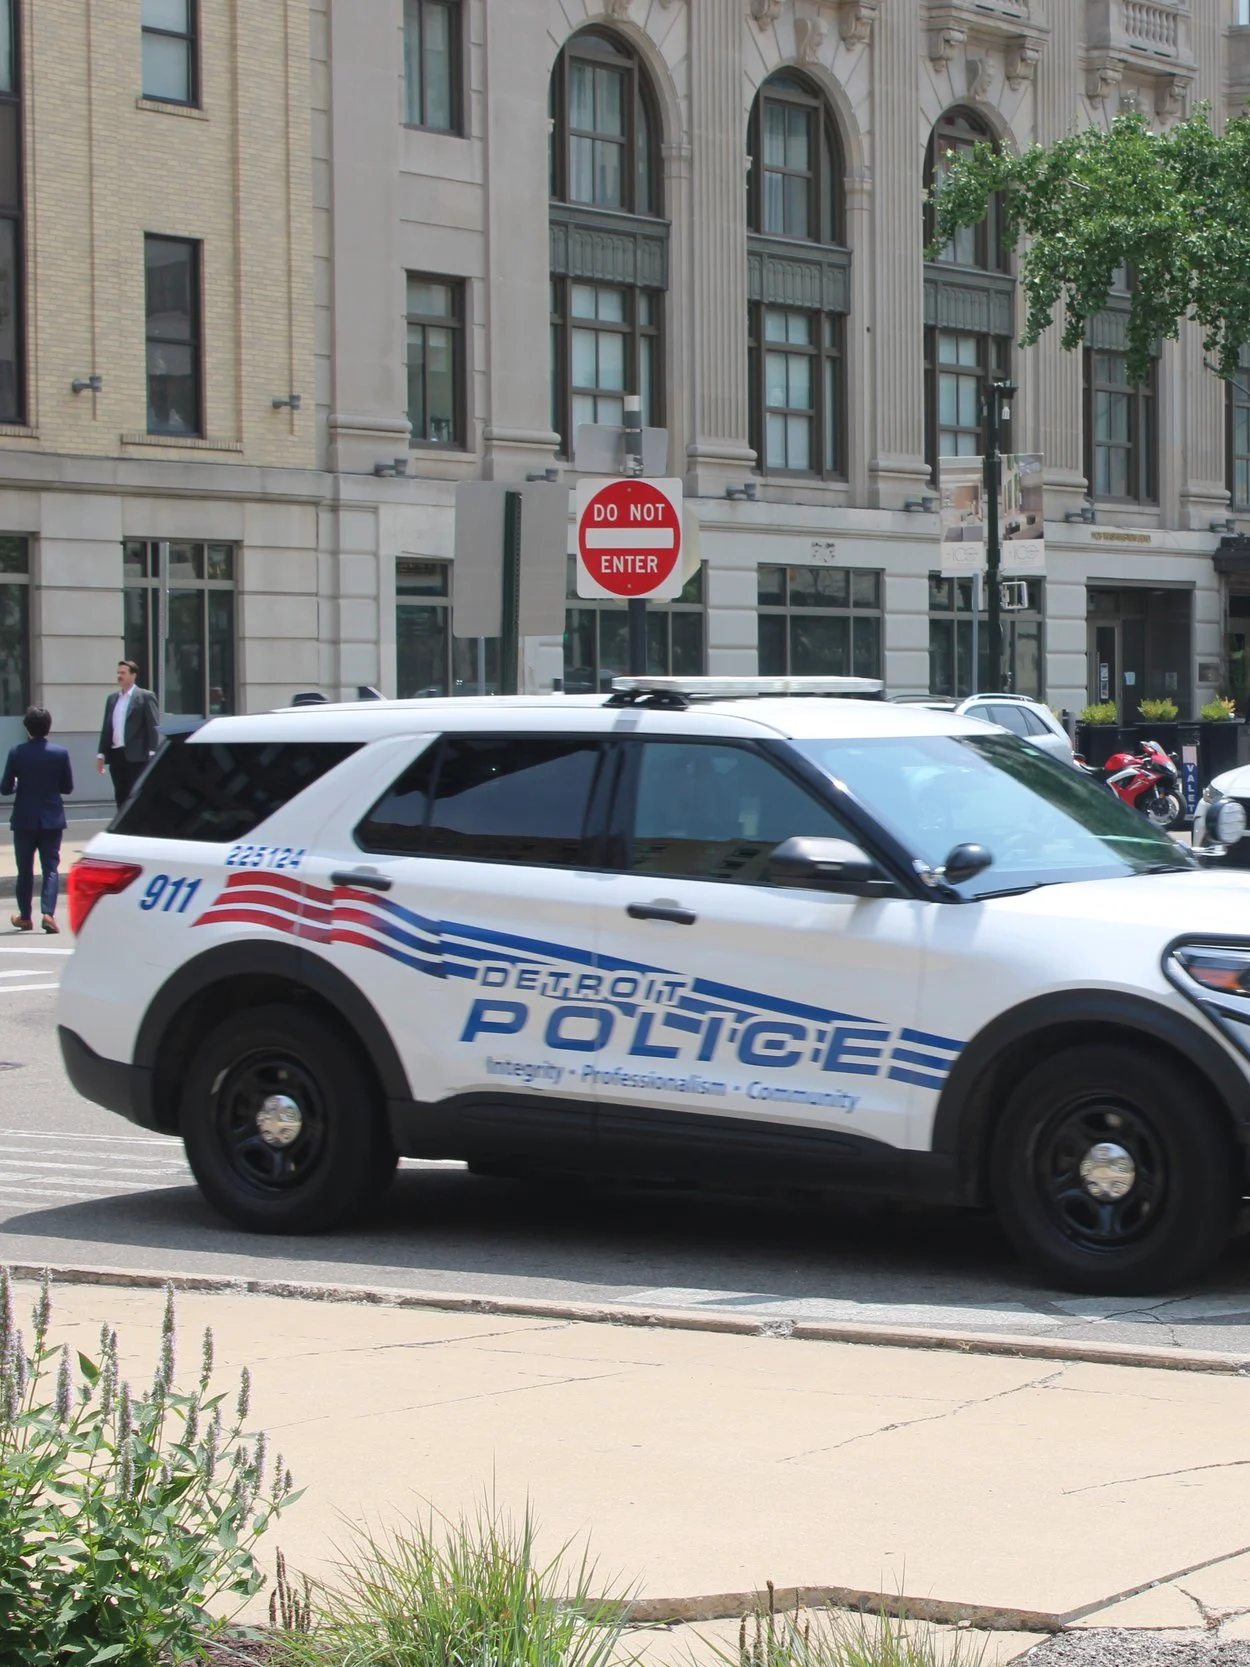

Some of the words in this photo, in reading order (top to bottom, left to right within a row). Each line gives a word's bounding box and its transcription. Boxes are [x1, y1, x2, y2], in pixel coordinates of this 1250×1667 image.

[593, 504, 618, 521] DO
[630, 504, 665, 521] NOT
[601, 556, 658, 573] ENTER
[1186, 764, 1195, 812] VALET
[224, 845, 307, 869] 225124
[140, 874, 203, 913] 911
[480, 965, 687, 1003] DETROIT
[459, 998, 892, 1076] POLICE
[486, 1055, 565, 1083] Integrity
[581, 1064, 728, 1098] Professionalism
[746, 1080, 862, 1114] Community
